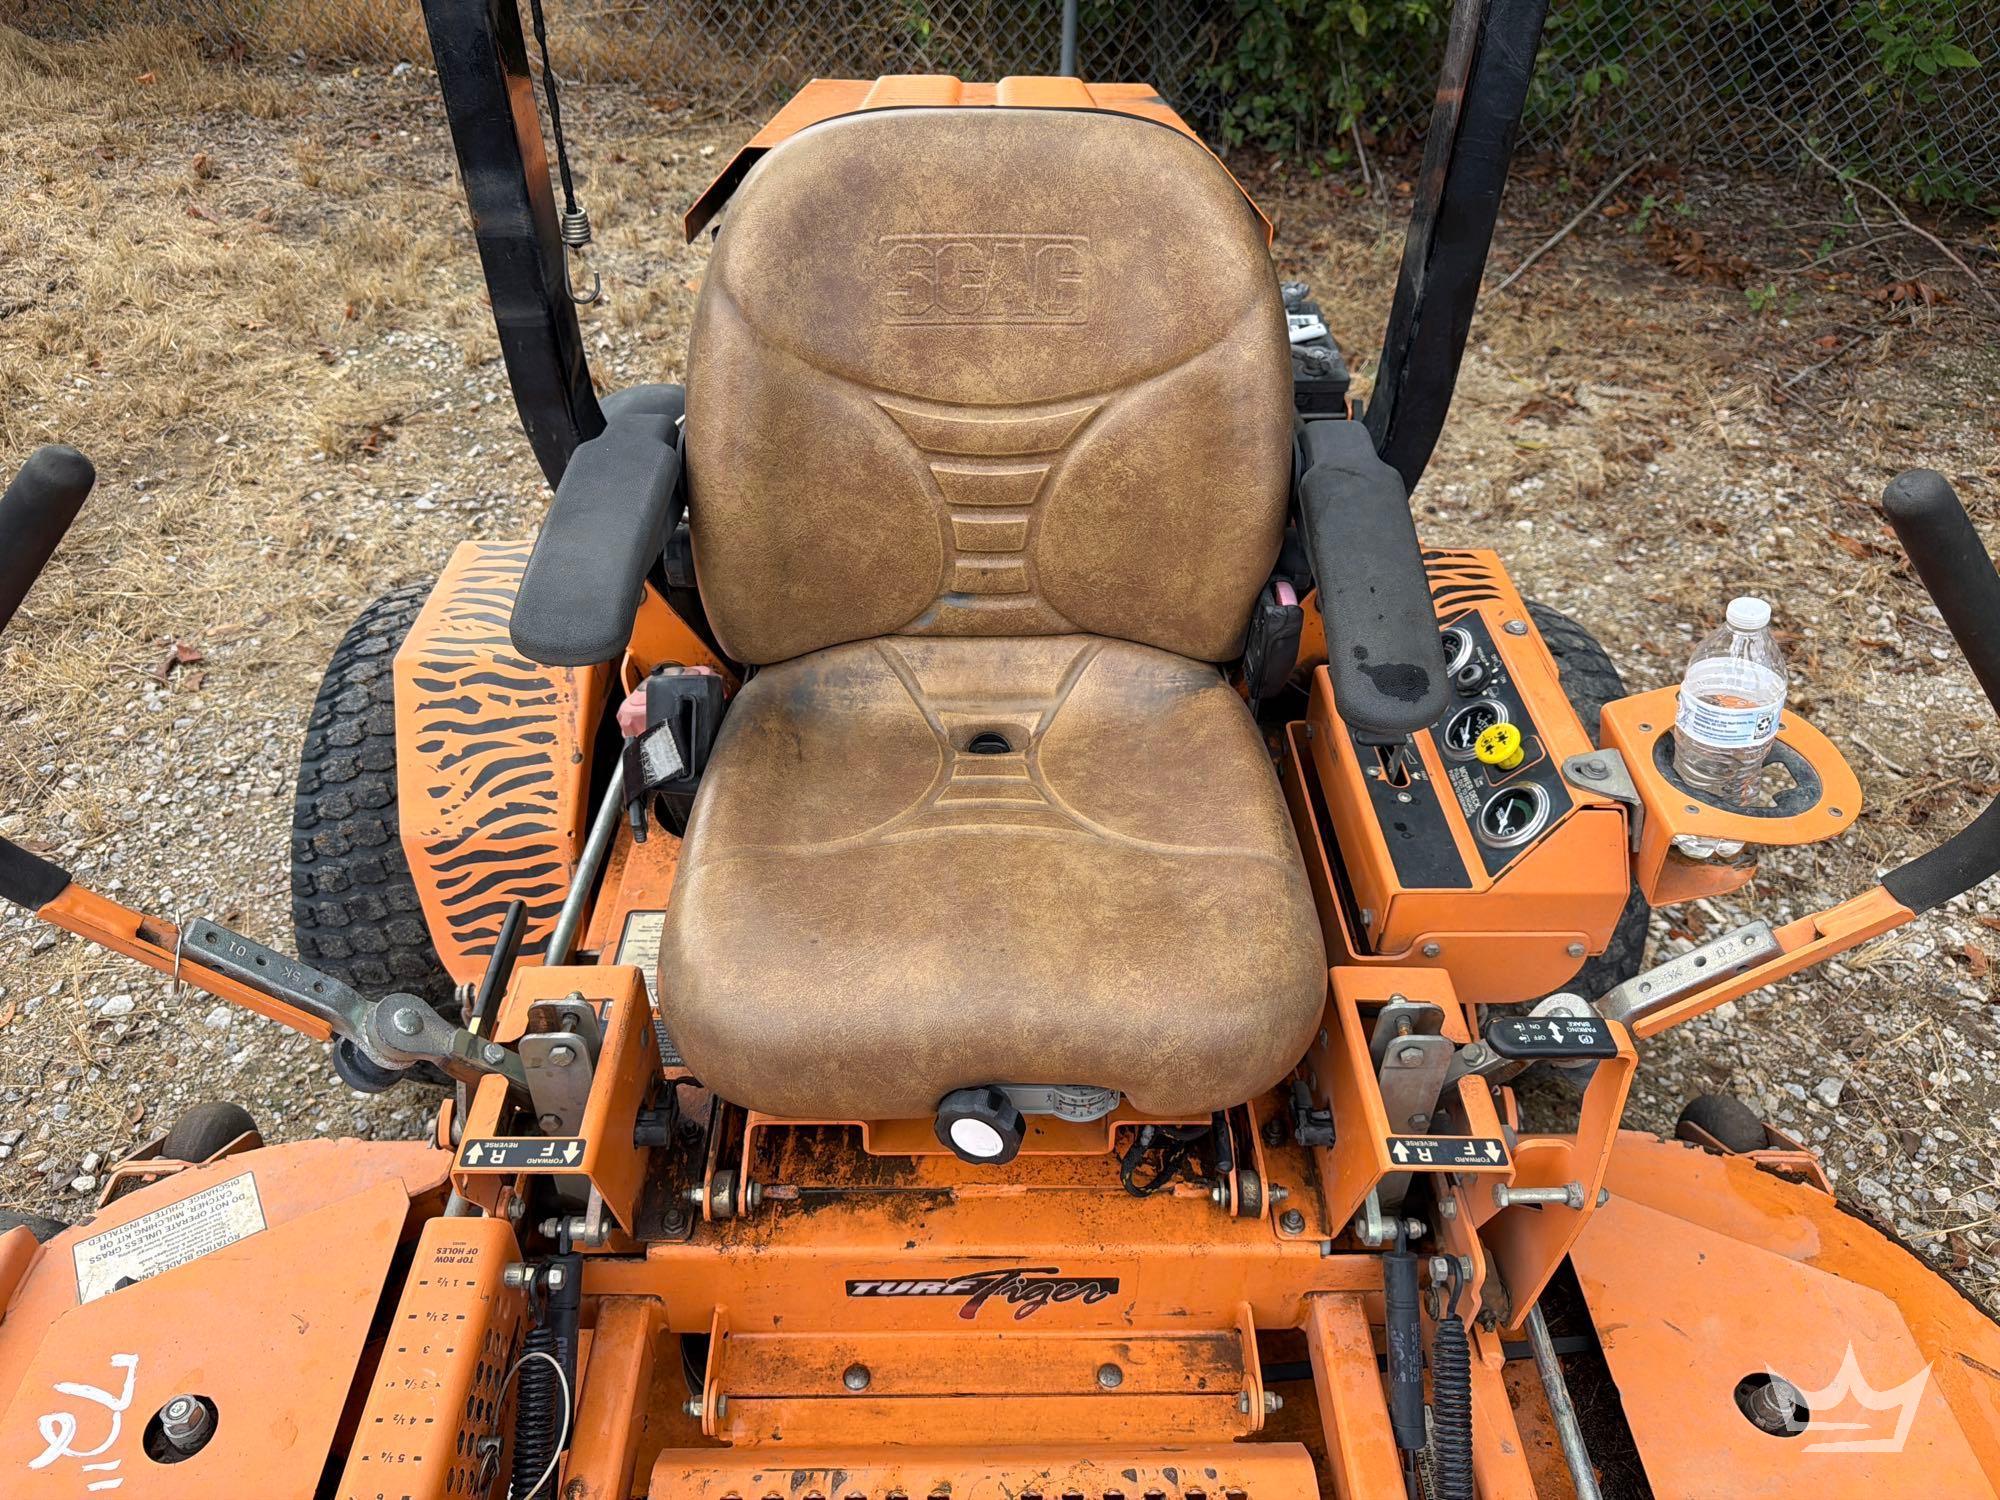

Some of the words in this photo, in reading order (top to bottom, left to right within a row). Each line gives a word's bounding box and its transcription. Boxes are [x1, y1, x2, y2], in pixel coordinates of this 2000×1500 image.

[1459, 765, 1474, 791] MOWER
[1468, 790, 1482, 810] DECK
[539, 1141, 554, 1156] F
[1416, 1147, 1432, 1161] R
[1463, 1141, 1475, 1154] F
[489, 1149, 506, 1163] R
[187, 1178, 239, 1204] DISCHARGE
[231, 1193, 245, 1203] DO
[153, 1202, 184, 1218] CHUTE
[209, 1201, 228, 1212] NOT
[132, 1210, 183, 1235] MULCHING
[165, 1210, 206, 1231] OPERATE
[88, 1221, 139, 1246] INSTALLED
[116, 1233, 131, 1243] KIT
[124, 1229, 161, 1248] UNLESS
[99, 1240, 113, 1250] OR
[195, 1233, 240, 1256] ROTATING
[89, 1246, 121, 1263] GRASS
[158, 1254, 193, 1272] BLADES
[453, 1279, 459, 1287] 1
[852, 1280, 977, 1295] TURF
[947, 1266, 1109, 1320] Tiger
[442, 1313, 449, 1321] 2
[423, 1345, 430, 1354] 3
[409, 1416, 416, 1424] 4
[397, 1454, 405, 1463] 5
